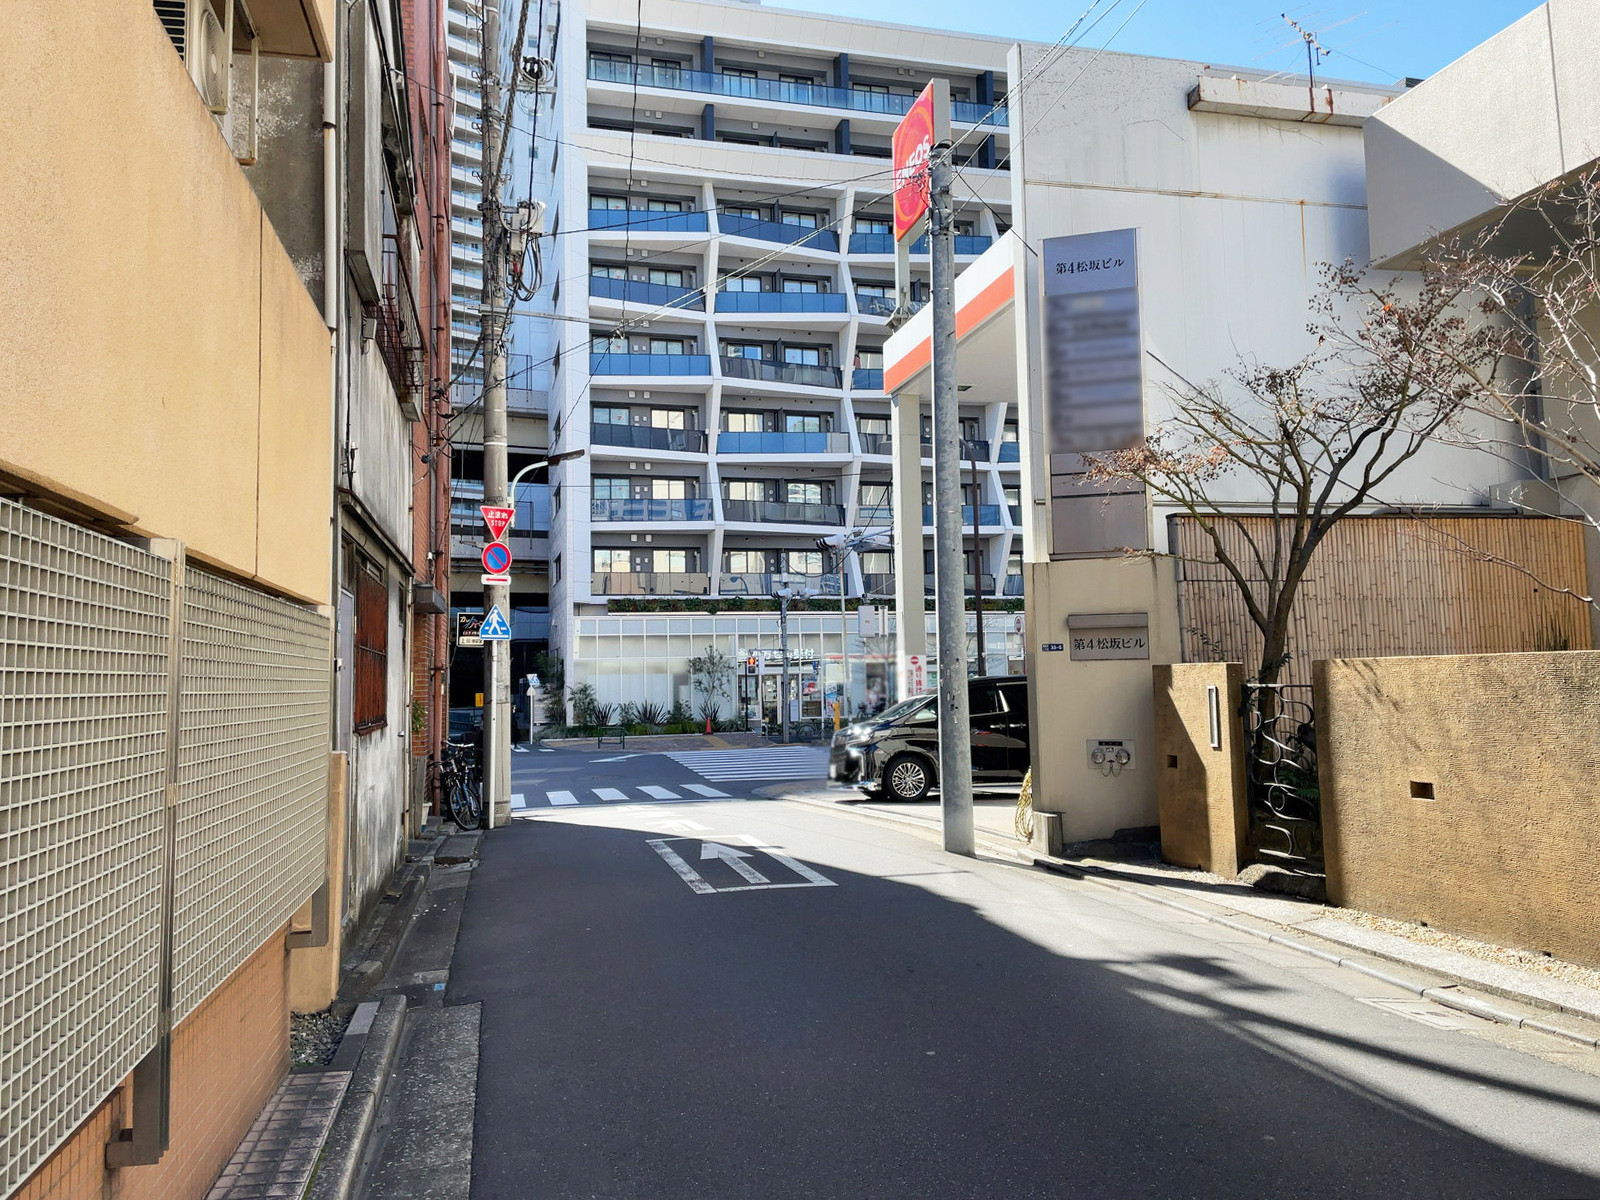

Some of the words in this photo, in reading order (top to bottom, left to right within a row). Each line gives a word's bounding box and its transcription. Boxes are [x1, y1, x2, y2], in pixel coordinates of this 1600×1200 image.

[896, 134, 930, 190] ENEOS
[1055, 257, 1125, 275] 第4松坂ビル
[487, 510, 508, 519] 止まれ
[490, 519, 506, 527] STOP
[1073, 638, 1145, 651] 第4松坂ビル
